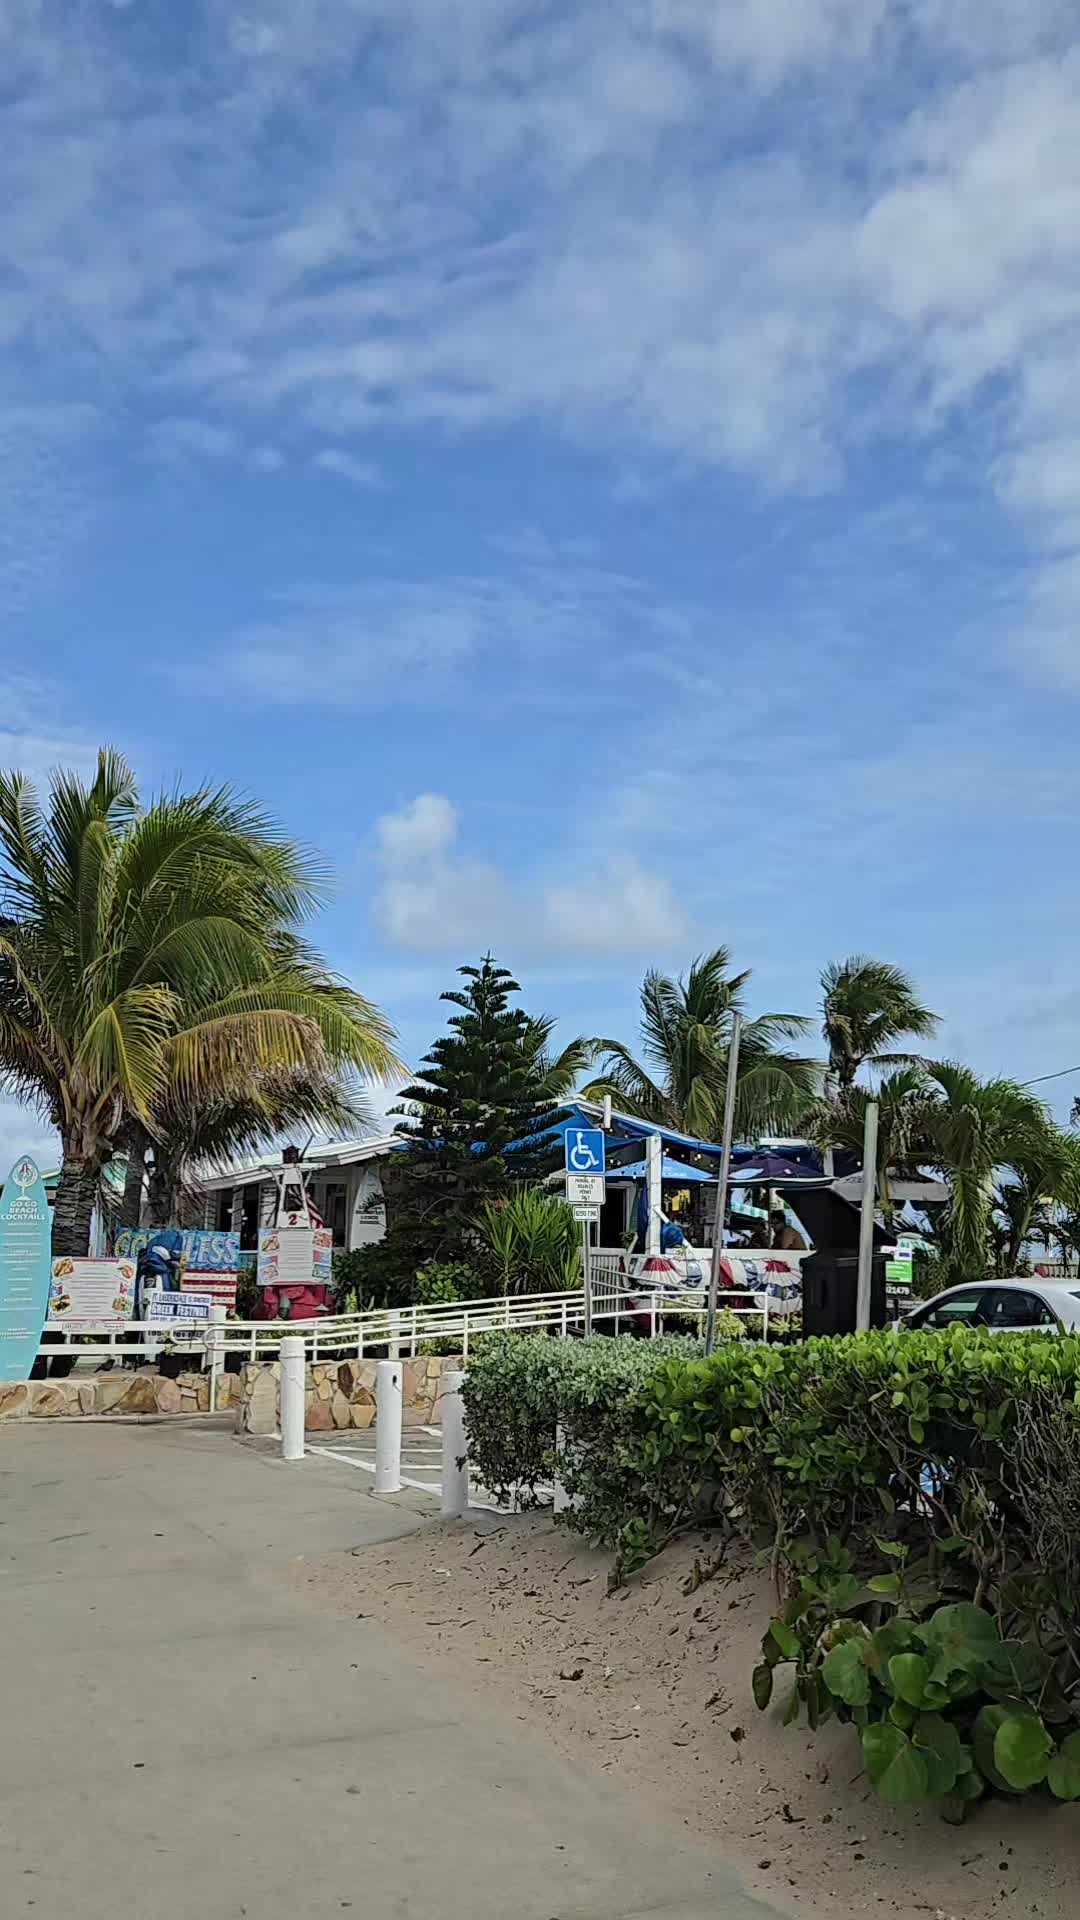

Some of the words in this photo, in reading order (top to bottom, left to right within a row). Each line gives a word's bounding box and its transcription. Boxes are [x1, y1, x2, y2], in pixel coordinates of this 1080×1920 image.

[288, 1213, 298, 1226] 2
[152, 1302, 175, 1315] GREEK
[176, 1304, 208, 1317] FESTIVAL
